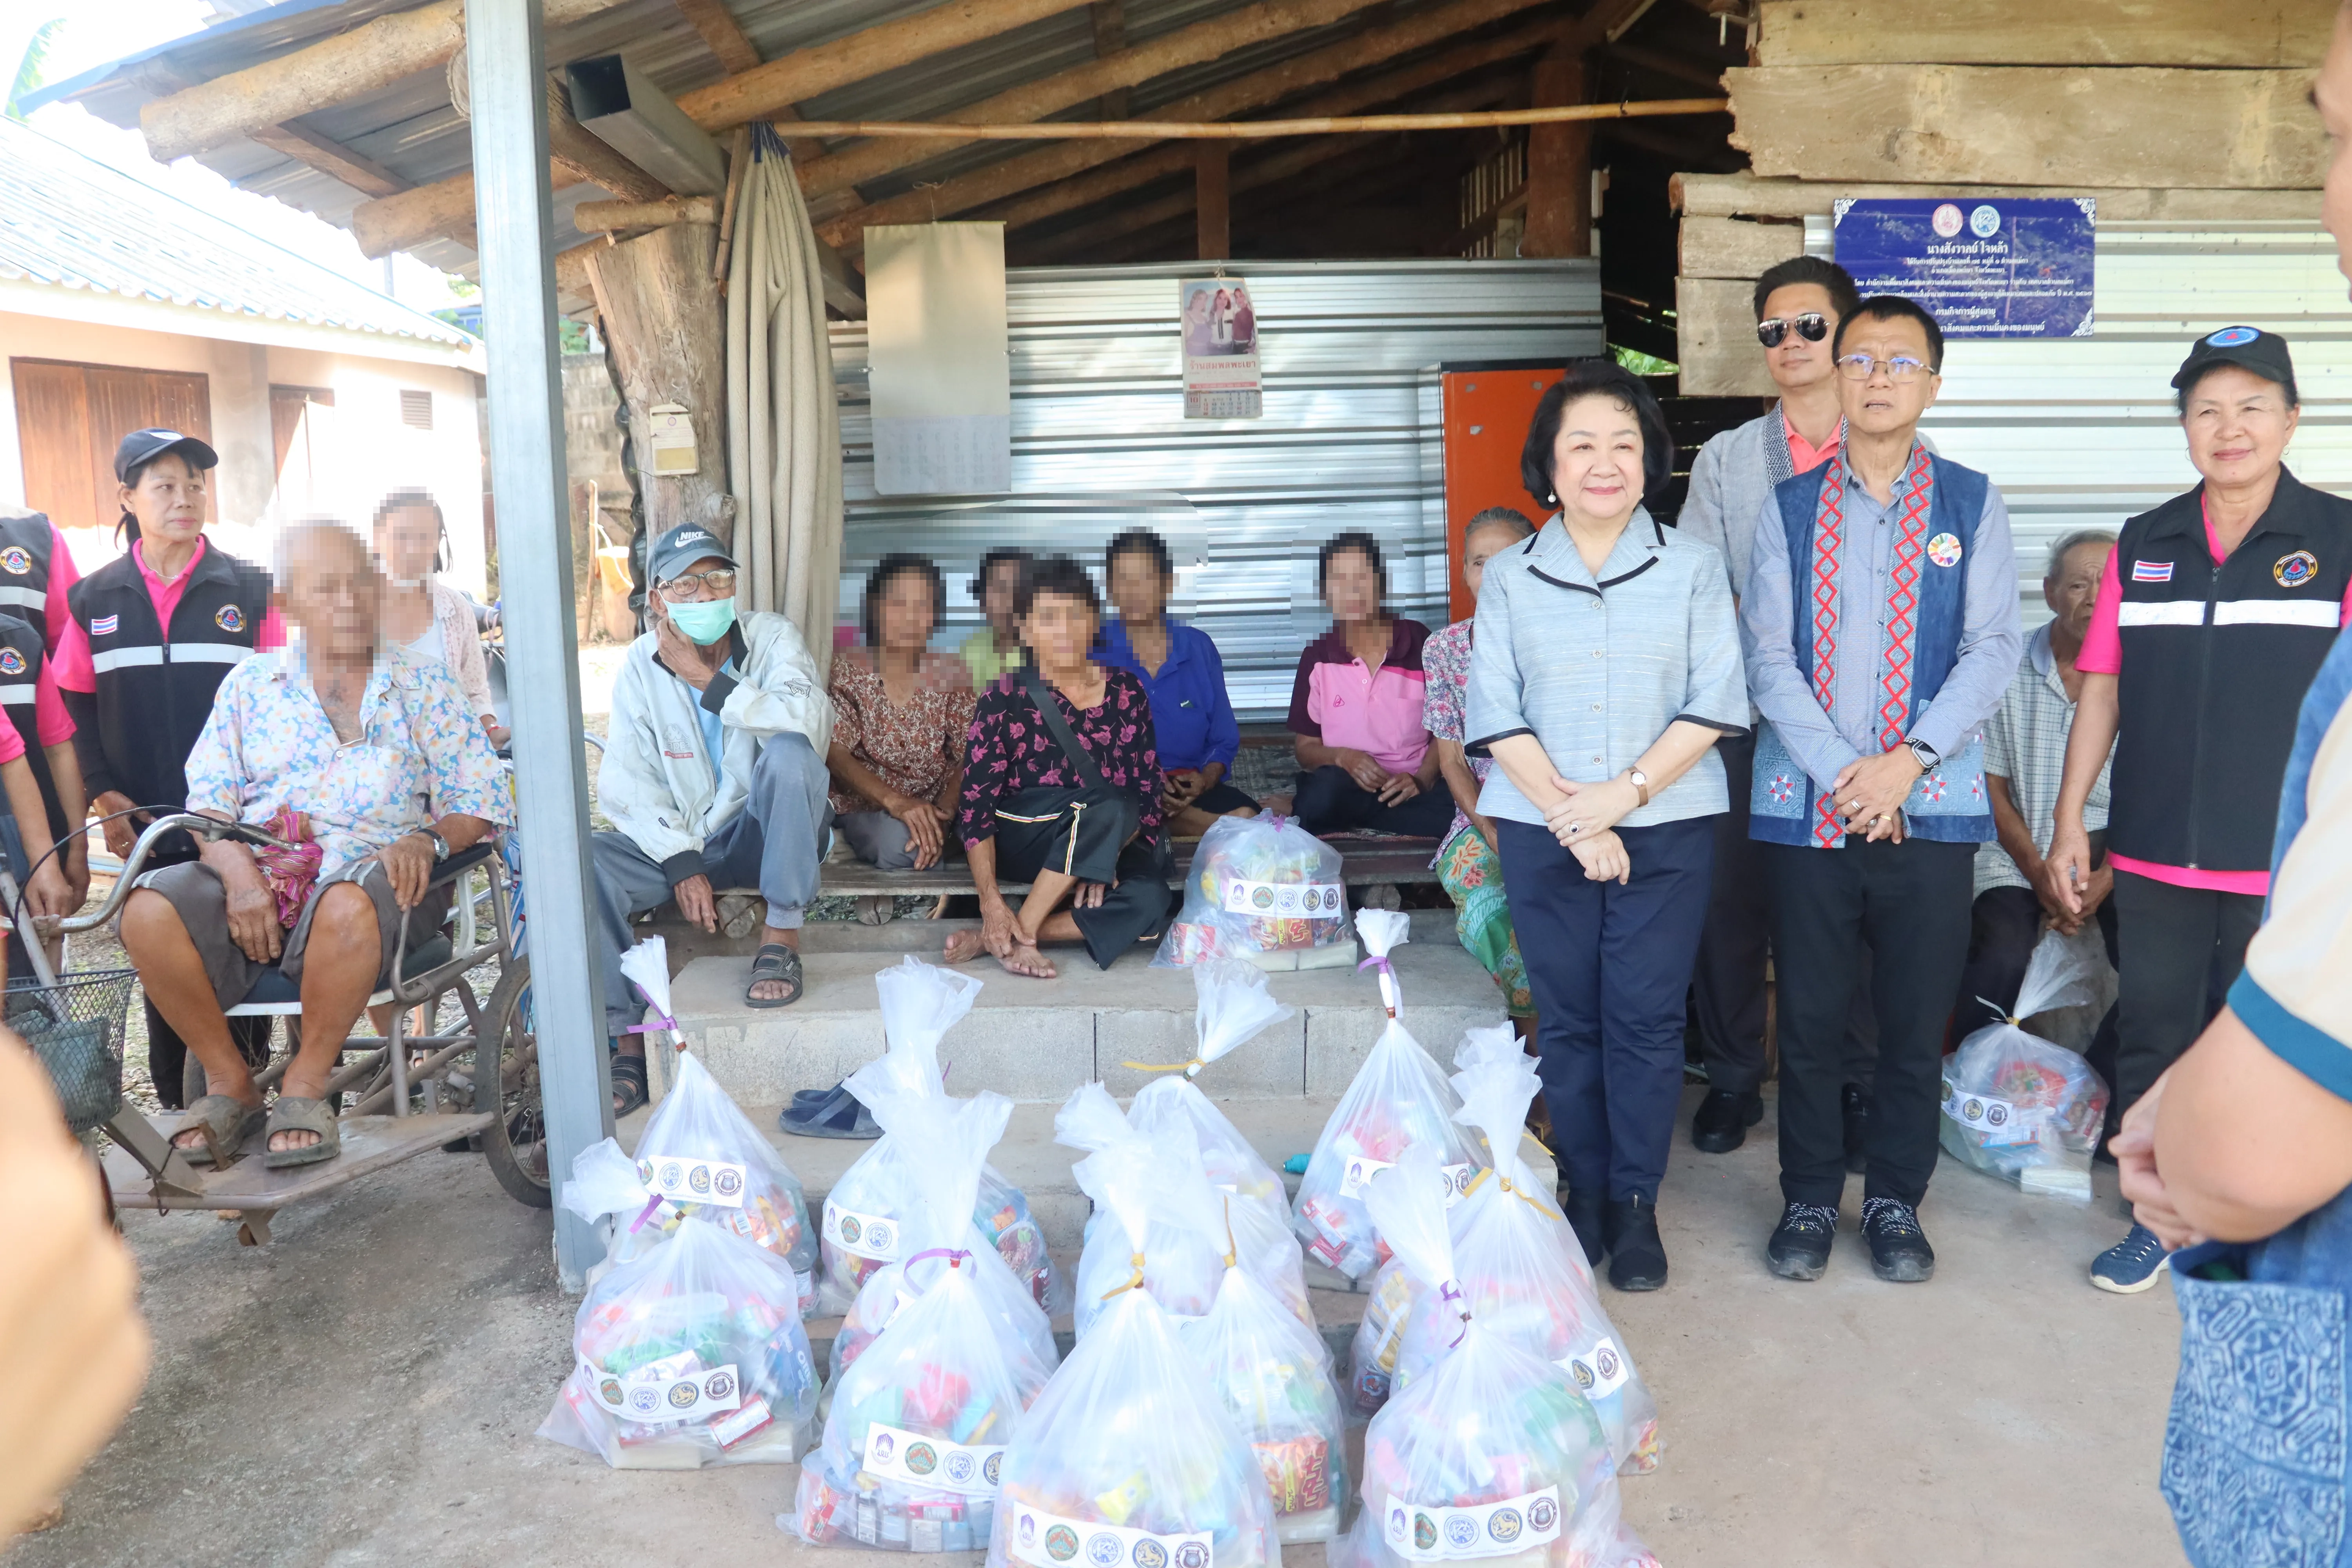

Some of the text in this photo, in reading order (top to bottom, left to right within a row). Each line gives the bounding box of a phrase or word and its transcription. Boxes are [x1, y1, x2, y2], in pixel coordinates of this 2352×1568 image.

[1927, 240, 2008, 254] นางสังวาลย์ ใจหล้า
[1189, 360, 1256, 369] ร้านสมพลพะเยา
[680, 532, 704, 540] NIKE
